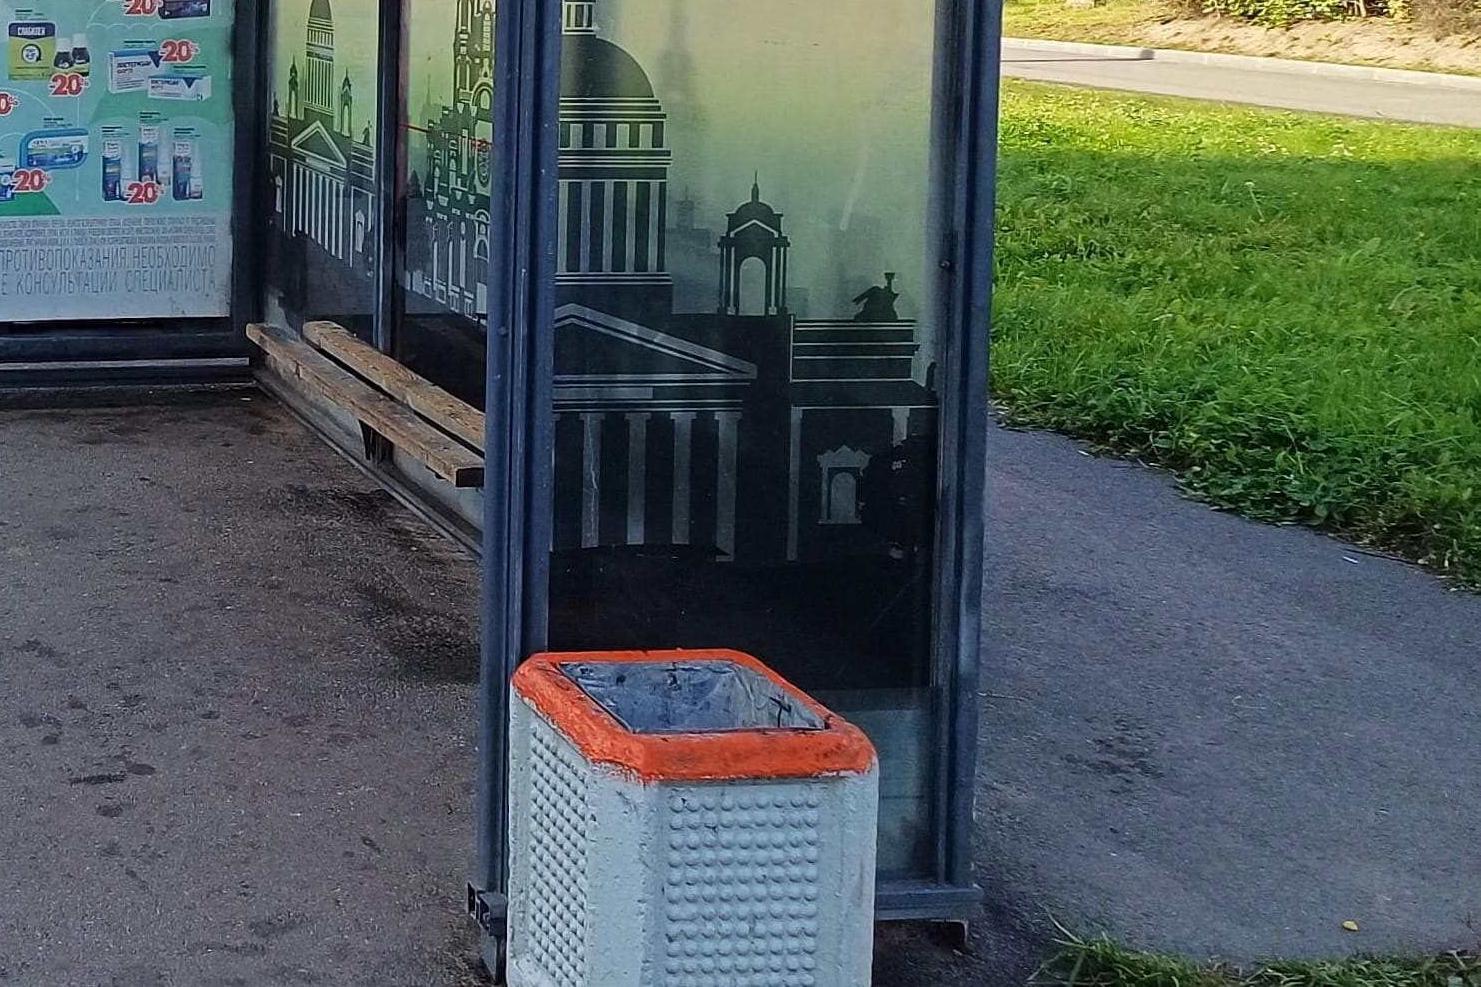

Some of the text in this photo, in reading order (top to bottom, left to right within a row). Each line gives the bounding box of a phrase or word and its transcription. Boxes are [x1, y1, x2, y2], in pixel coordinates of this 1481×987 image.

[133, 245, 216, 269] НЕОБХОДИМО
[16, 270, 118, 295] КОНСУЛЬТАЦИИ
[125, 268, 216, 293] СПЕЦИАЛИСТА
